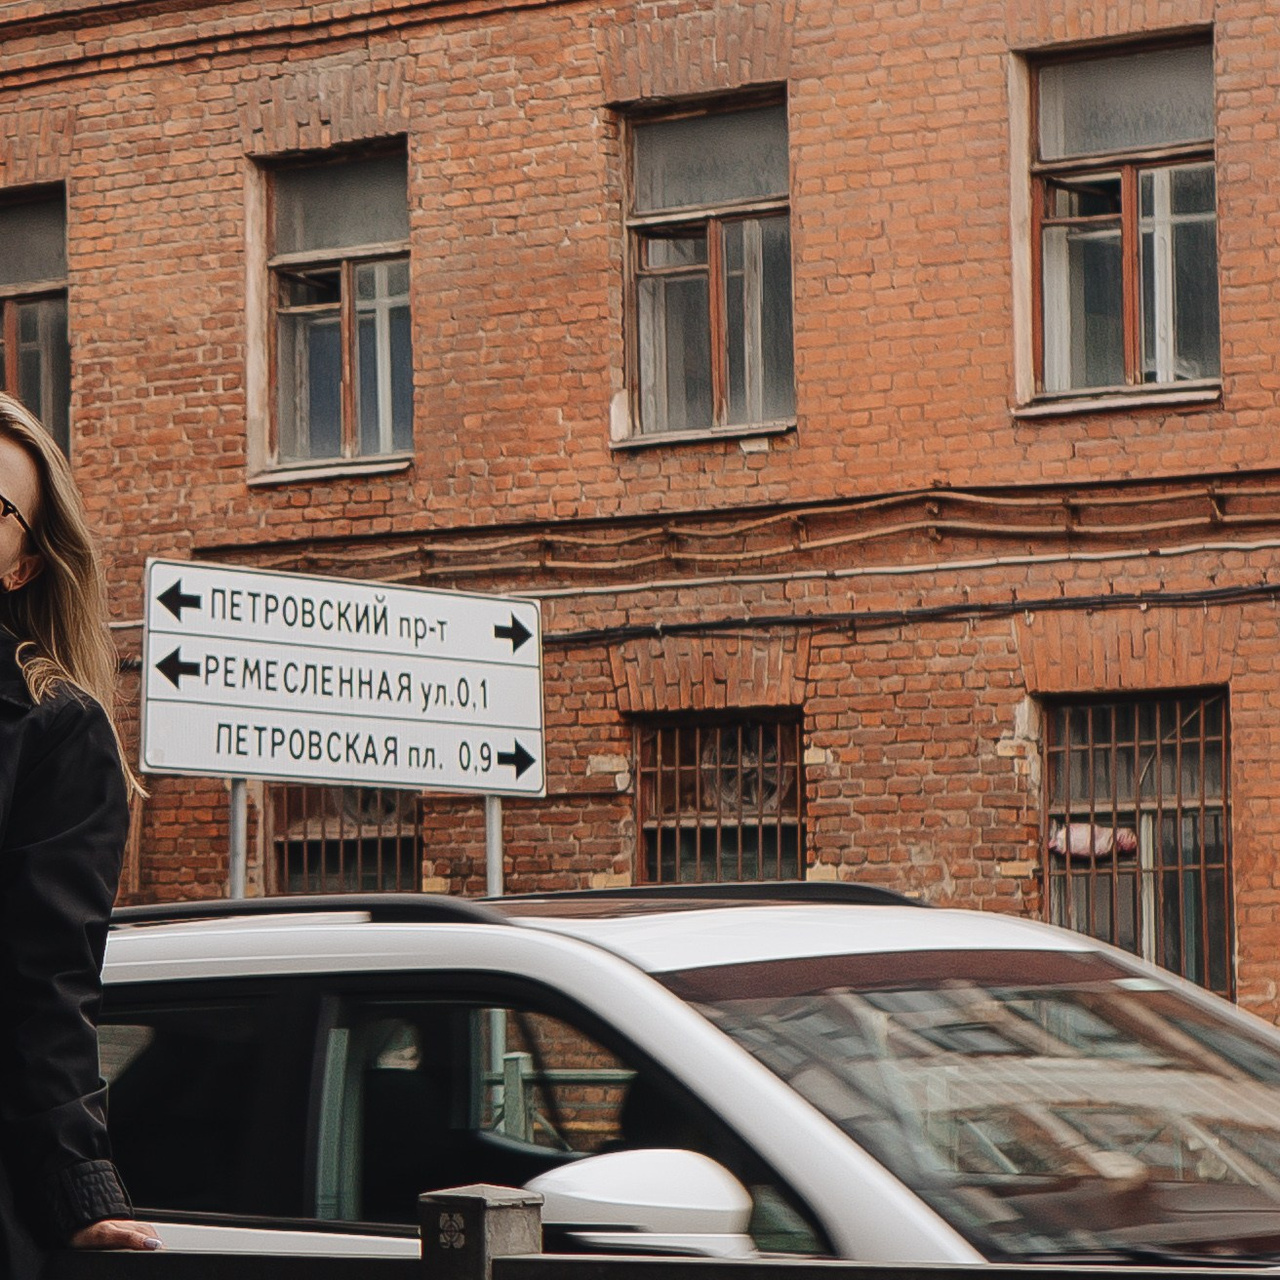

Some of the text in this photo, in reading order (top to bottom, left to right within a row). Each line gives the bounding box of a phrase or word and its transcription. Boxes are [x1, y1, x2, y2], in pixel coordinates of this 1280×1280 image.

[211, 587, 448, 649] ПЕТРОВСКИЙ пр-т
[204, 654, 412, 703] РЕМЕСЛЕННАЯ
[216, 723, 492, 775] ПЕТРОВСКАЯ пл. 0,9
